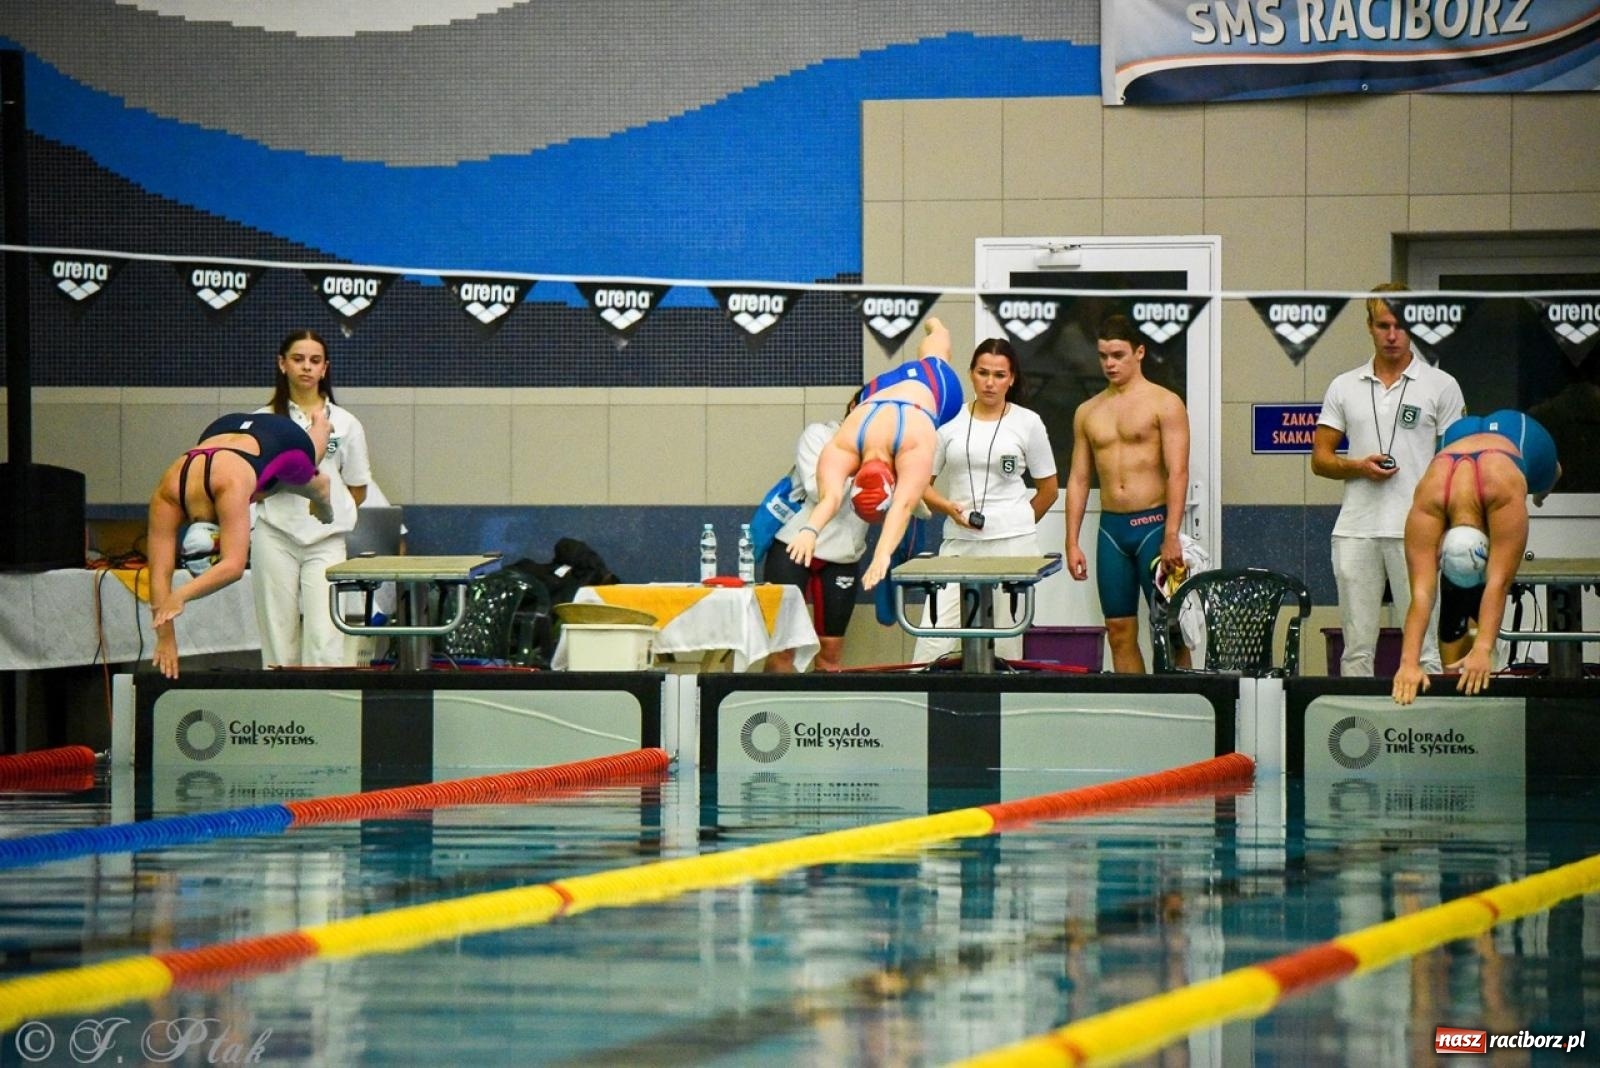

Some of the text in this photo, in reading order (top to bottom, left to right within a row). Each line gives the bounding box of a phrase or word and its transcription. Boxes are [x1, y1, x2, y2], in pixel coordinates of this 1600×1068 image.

[1186, 0, 1286, 45] SMS
[52, 260, 110, 281] arena
[191, 269, 248, 289] arena
[323, 276, 379, 296] arena
[460, 283, 516, 303] arena
[595, 289, 651, 309] arena
[728, 294, 784, 313] arena
[863, 298, 920, 317] arena
[999, 301, 1057, 319] arena
[1133, 302, 1190, 321] arena
[1269, 304, 1327, 323] arena
[1404, 304, 1462, 323] arena
[1129, 514, 1164, 527] arena
[230, 735, 258, 745] TIME
[796, 737, 823, 747] TIME
[1386, 744, 1415, 753] TIME
